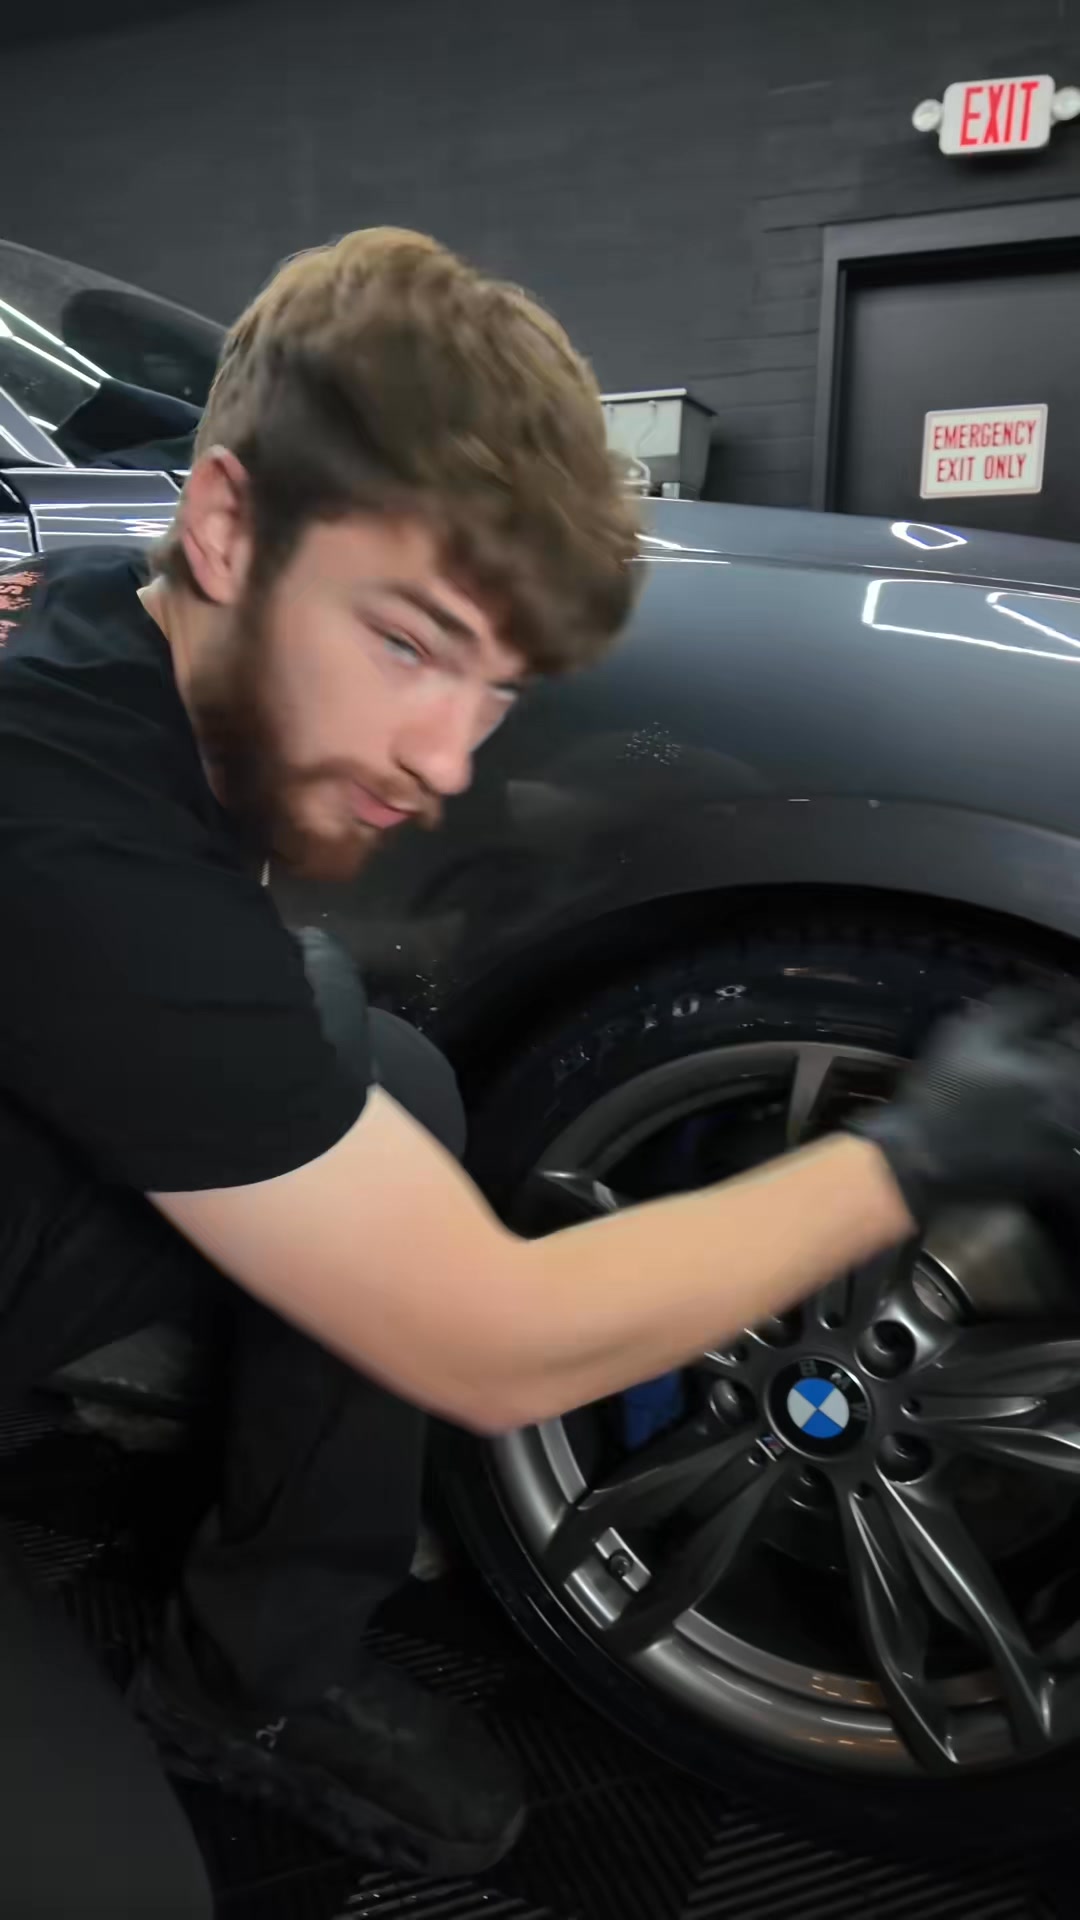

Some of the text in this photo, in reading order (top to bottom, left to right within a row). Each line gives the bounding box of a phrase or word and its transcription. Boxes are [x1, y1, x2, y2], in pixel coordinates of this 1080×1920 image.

[960, 82, 1039, 146] EXIT
[934, 421, 1036, 450] EMERGENCY
[937, 453, 1027, 483] EXIT ONLY
